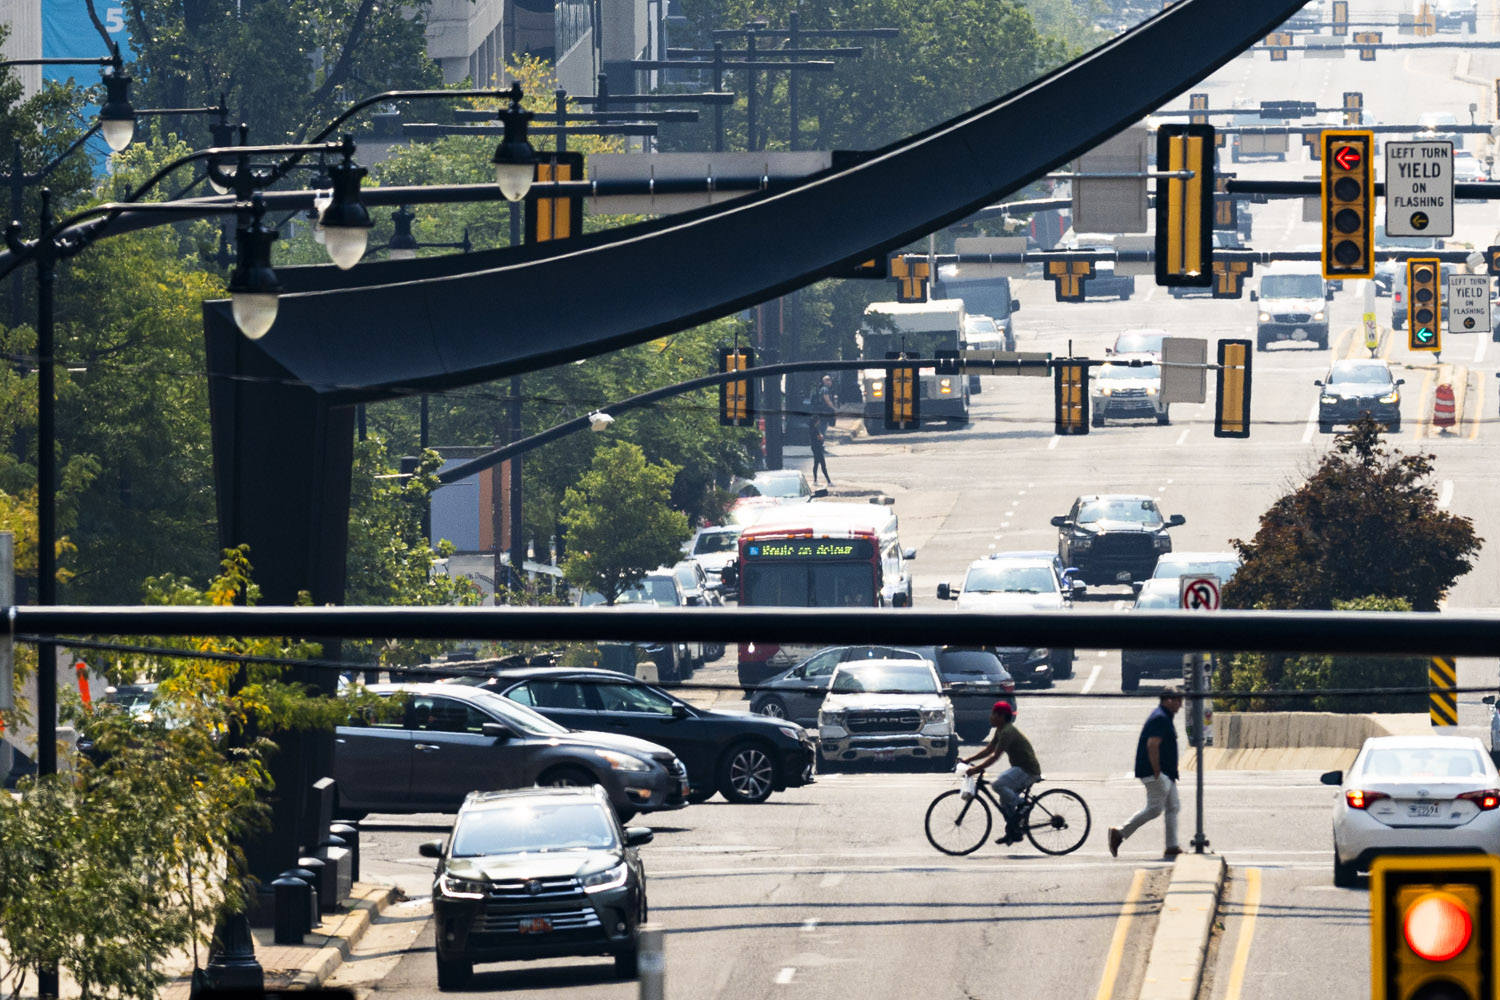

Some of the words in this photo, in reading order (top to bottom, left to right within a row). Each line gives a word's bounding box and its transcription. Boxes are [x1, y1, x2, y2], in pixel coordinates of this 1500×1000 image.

[1391, 147, 1415, 159] LEFT
[1421, 147, 1448, 159] TURN
[1398, 162, 1441, 178] YIELD
[1412, 182, 1427, 194] ON
[1394, 196, 1445, 208] FLASHING
[1451, 278, 1466, 286] LEFT
[1456, 287, 1483, 298] YIELD
[1453, 307, 1485, 315] FLASHING
